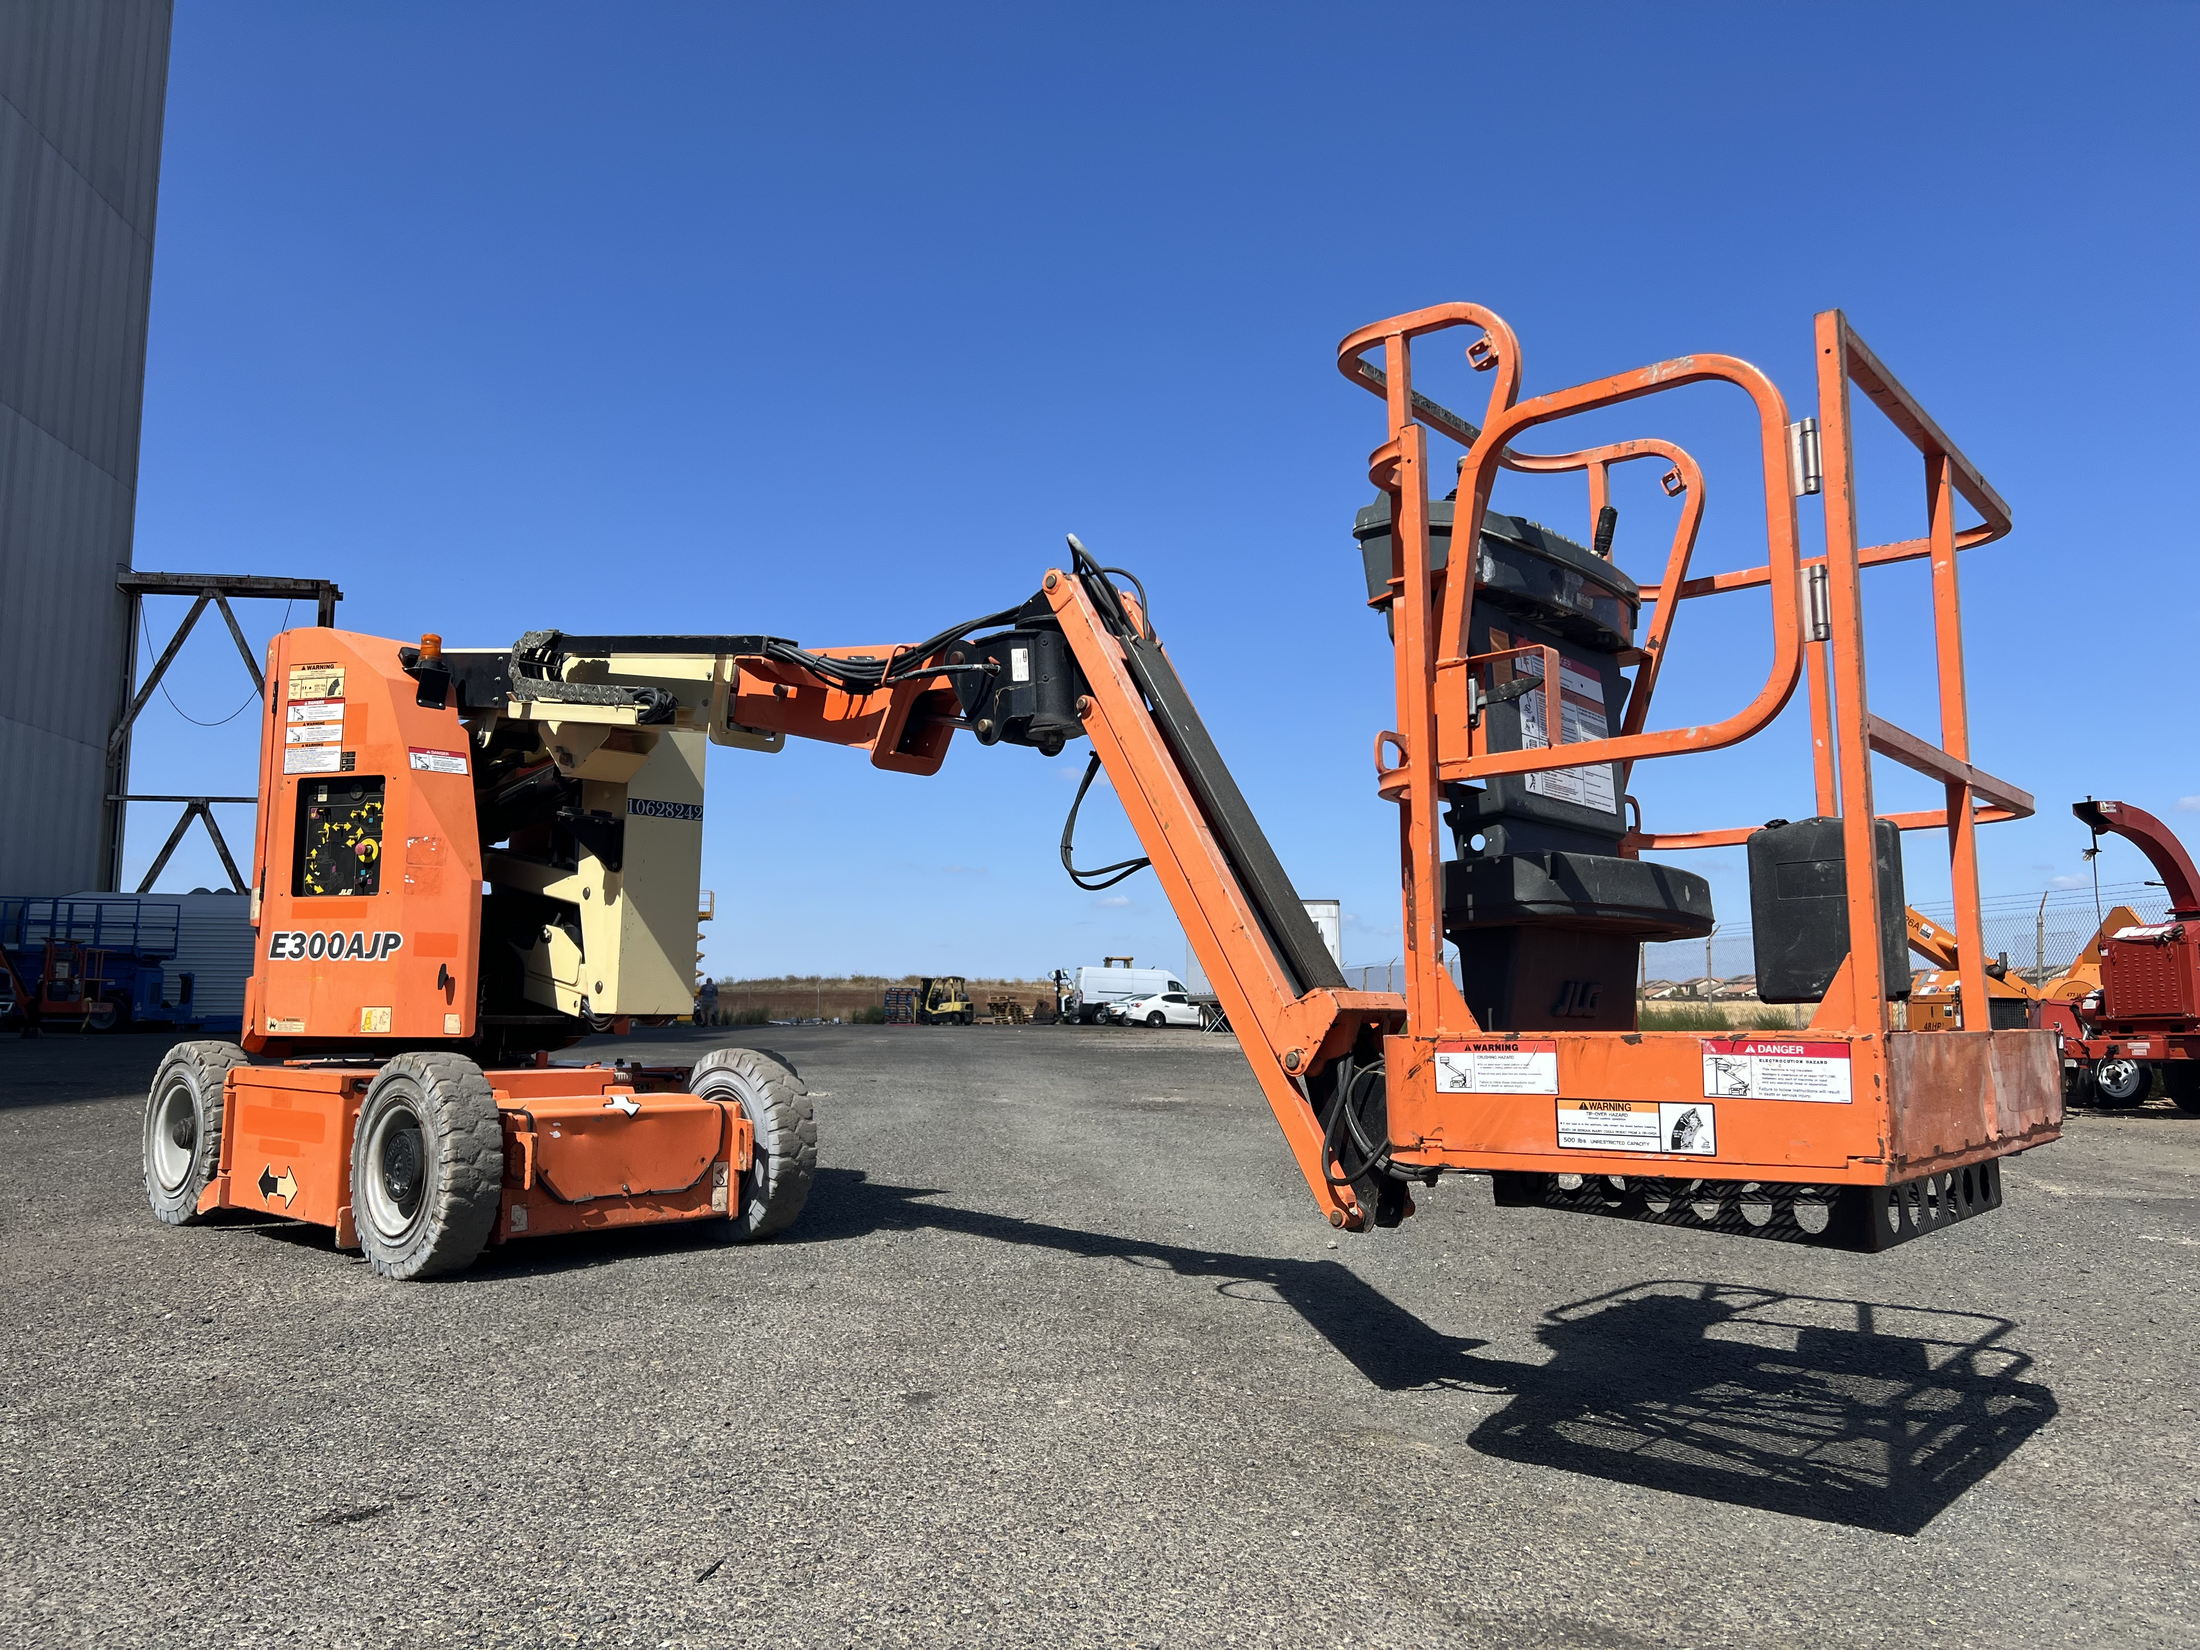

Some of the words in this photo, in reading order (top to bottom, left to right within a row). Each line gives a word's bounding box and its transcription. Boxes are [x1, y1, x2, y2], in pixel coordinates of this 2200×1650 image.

[306, 663, 335, 671] WARNING
[628, 799, 703, 820] 10628242
[268, 931, 403, 961] E300AJP
[1549, 980, 1604, 1017] JLG
[1473, 1044, 1519, 1052] WARNING
[1757, 1044, 1804, 1054] DANGER
[1588, 1102, 1632, 1112] WARNING
